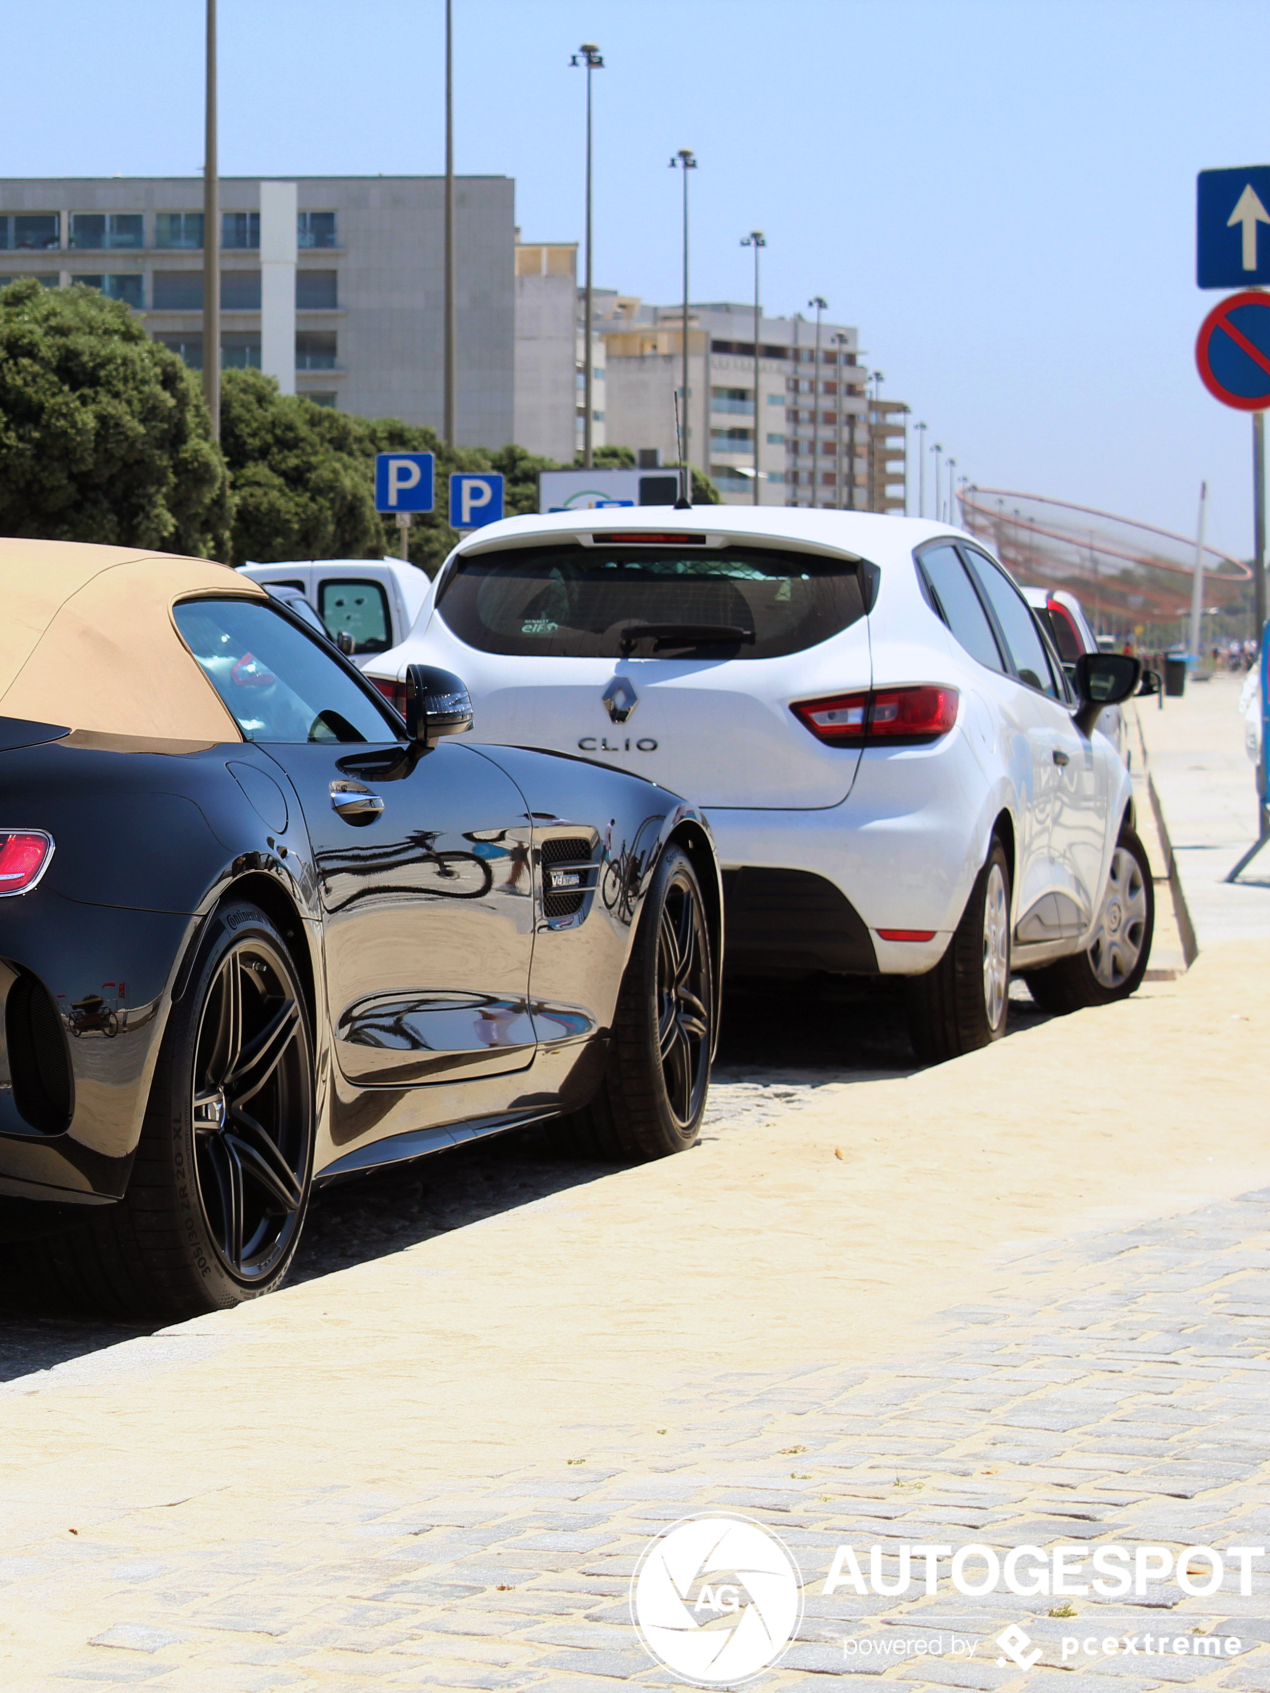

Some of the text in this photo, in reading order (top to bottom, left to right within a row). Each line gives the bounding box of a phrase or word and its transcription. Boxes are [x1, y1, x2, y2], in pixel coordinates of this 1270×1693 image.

[388, 459, 421, 506] P
[461, 479, 492, 523] P
[578, 737, 658, 751] CLIO
